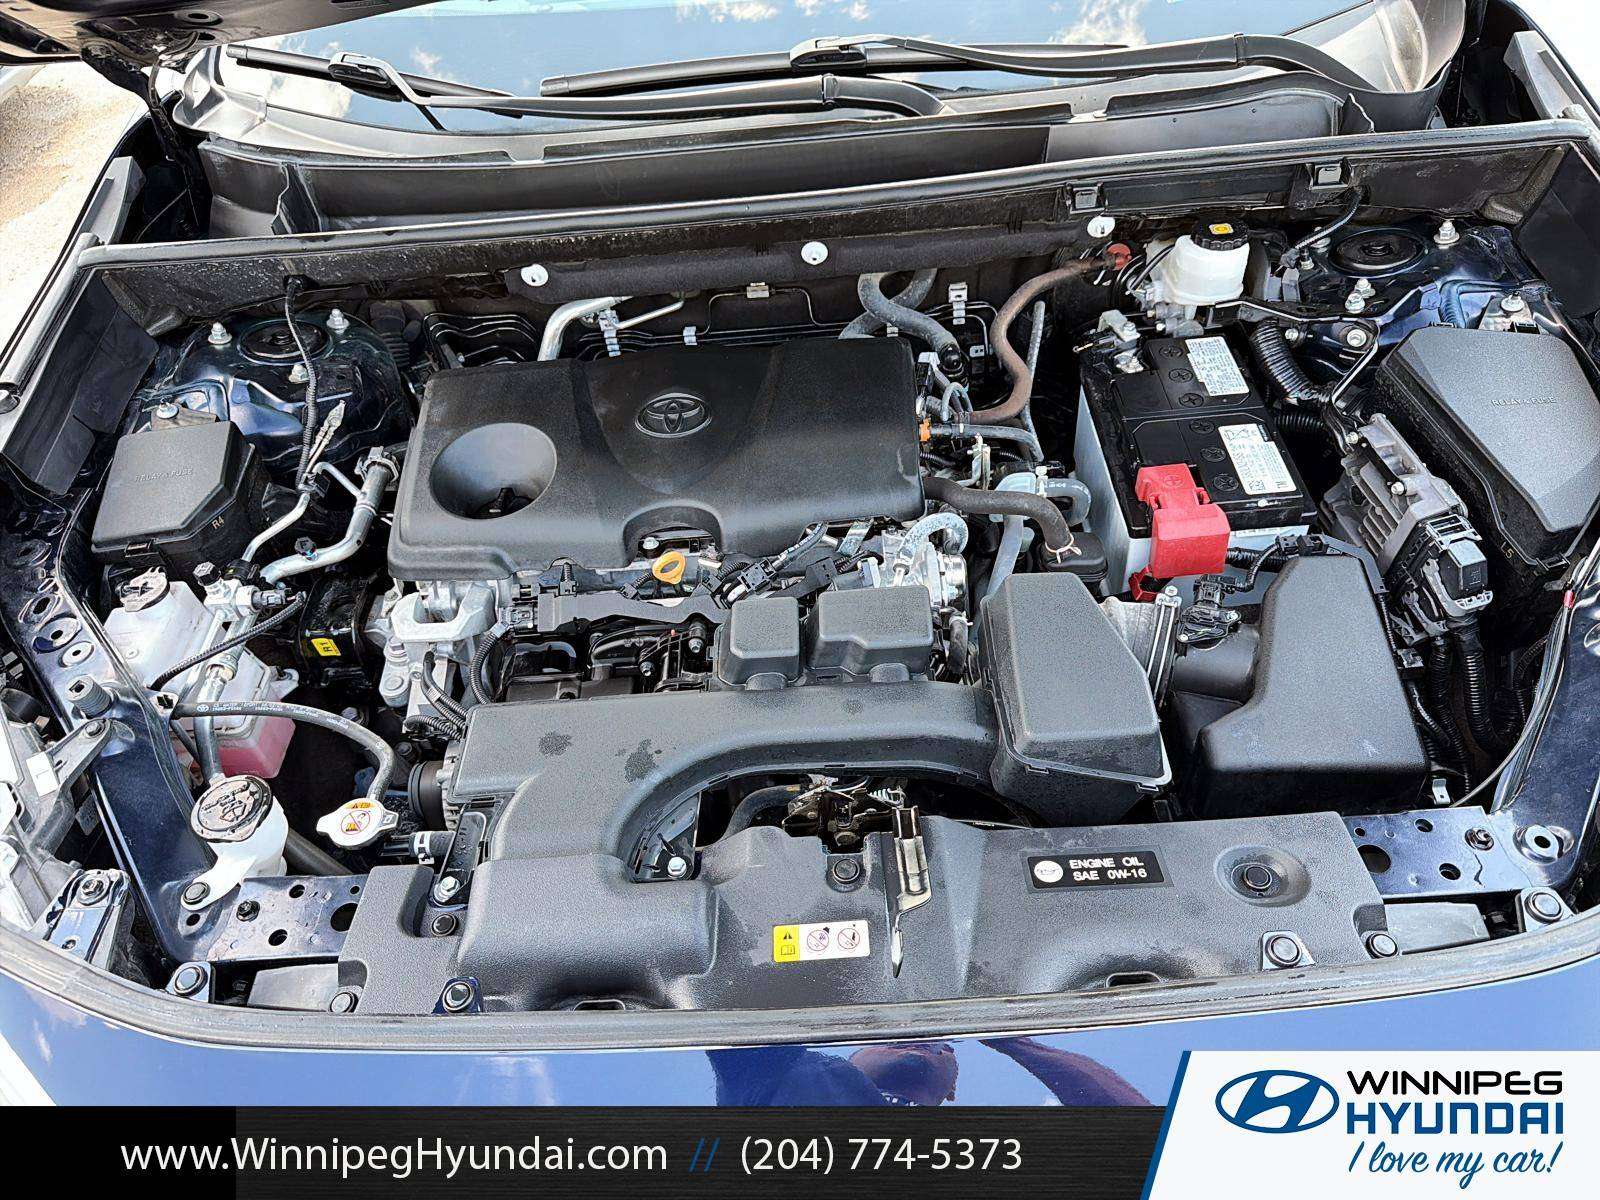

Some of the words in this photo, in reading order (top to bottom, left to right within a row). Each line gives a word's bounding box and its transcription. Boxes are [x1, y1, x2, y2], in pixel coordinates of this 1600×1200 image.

[211, 515, 225, 530] R4
[1500, 541, 1515, 559] L5
[1069, 857, 1116, 869] ENGINE
[1122, 856, 1145, 867] OIL
[1073, 870, 1100, 881] SAE
[1107, 868, 1148, 880] 0W-16
